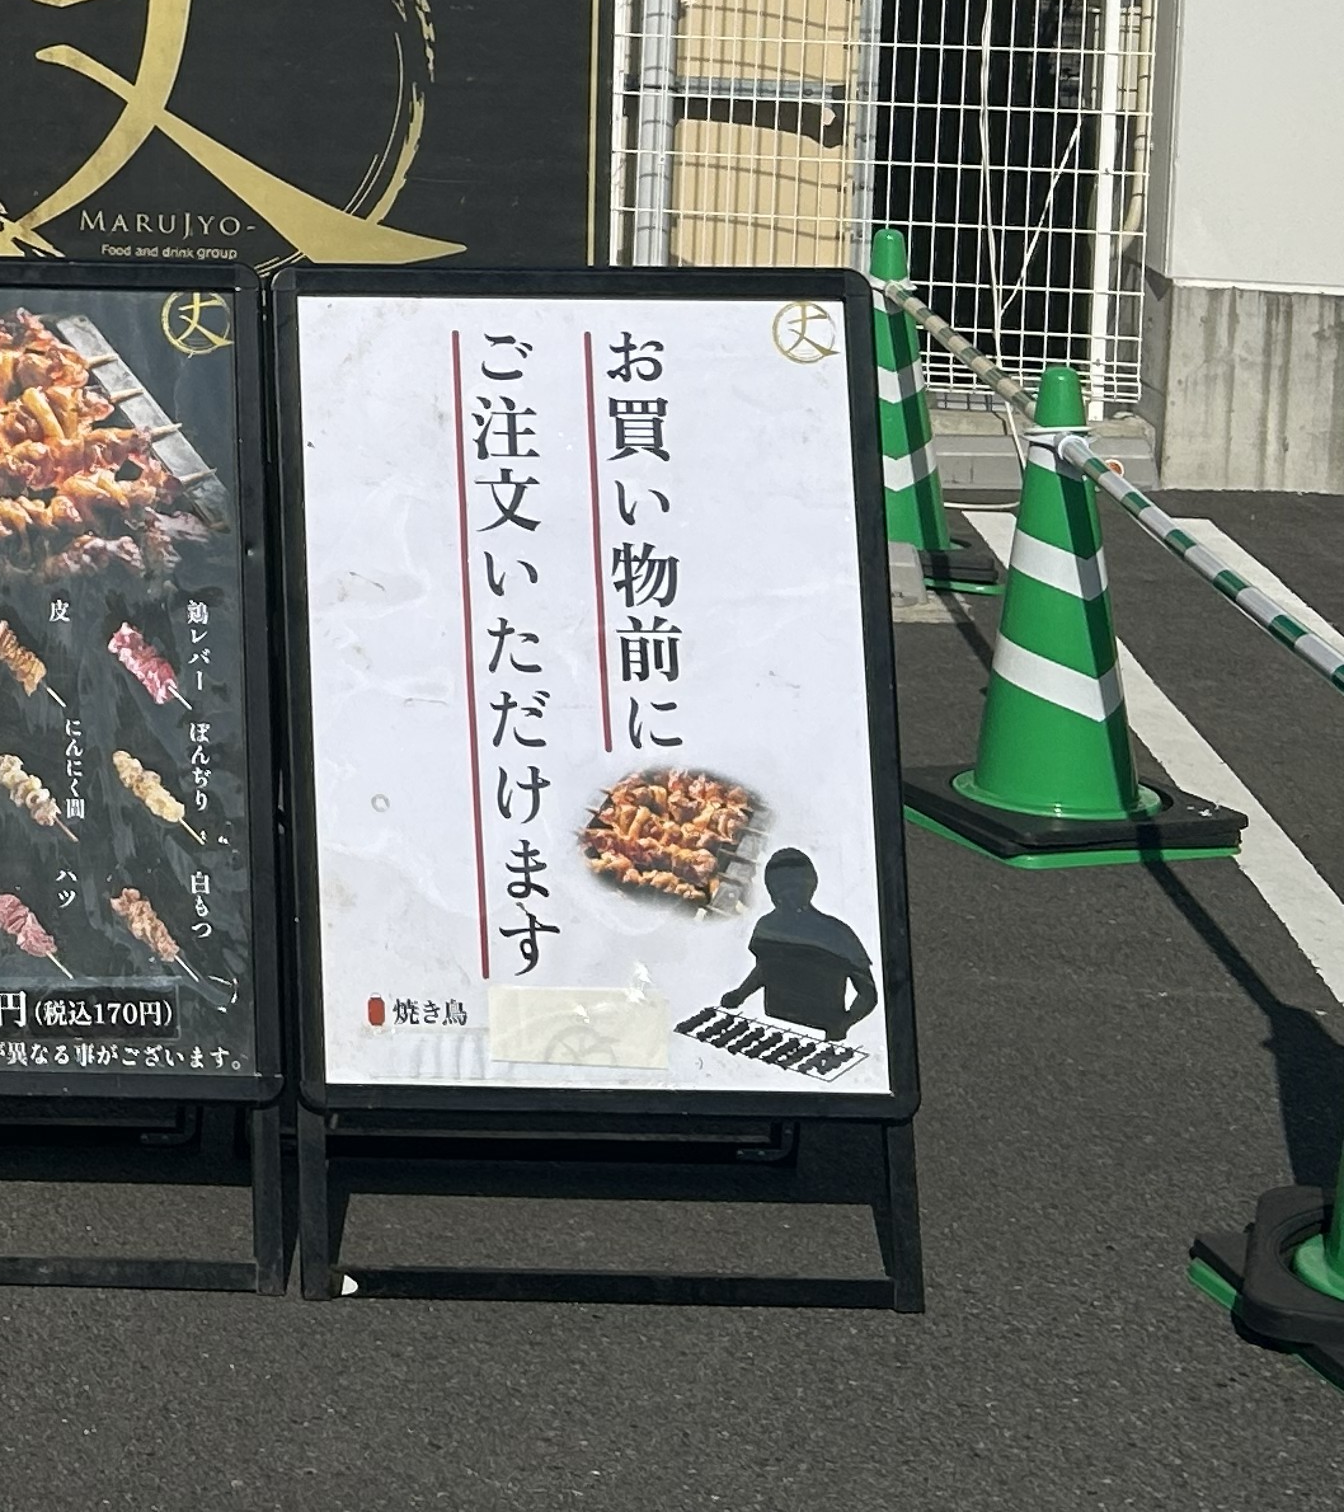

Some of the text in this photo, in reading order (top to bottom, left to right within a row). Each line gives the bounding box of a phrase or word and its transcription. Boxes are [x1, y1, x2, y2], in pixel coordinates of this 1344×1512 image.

[101, 244, 237, 260] Food and drink group
[606, 330, 685, 751] お買い物前に
[48, 599, 71, 622] 皮
[187, 599, 211, 692] 鶏レバー
[471, 330, 561, 978] ご注文いただけます
[65, 719, 85, 820] にんにく間
[55, 868, 78, 908] ハツ
[190, 872, 212, 939] 白もつ
[34, 997, 174, 1029] (税込170円)
[393, 997, 468, 1027] 焼き鳥
